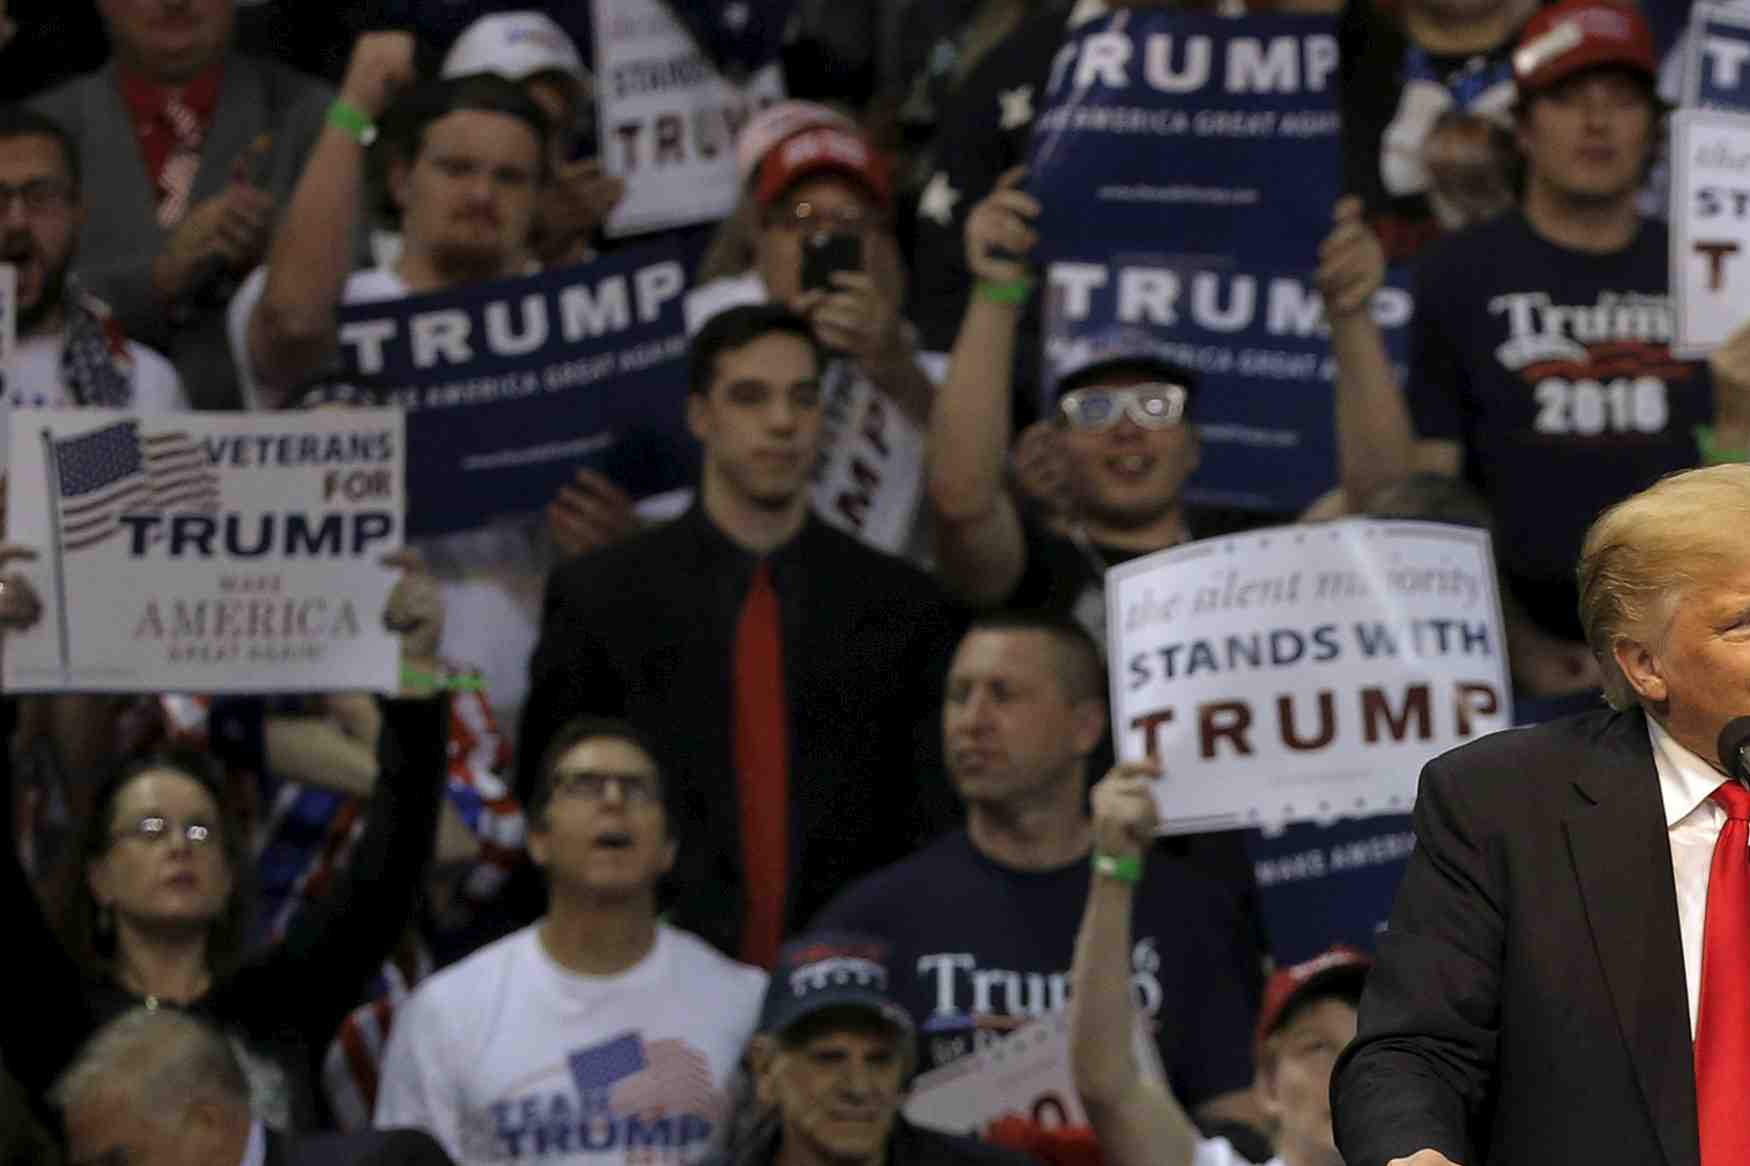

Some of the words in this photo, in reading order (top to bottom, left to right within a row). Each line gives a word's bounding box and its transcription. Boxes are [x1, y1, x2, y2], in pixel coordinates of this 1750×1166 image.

[1052, 31, 1339, 94] RUMP
[336, 259, 686, 375] TRUMP
[1488, 290, 1673, 345] Trum
[1533, 376, 1667, 434] 2016
[204, 431, 393, 467] VETERANS
[323, 469, 392, 500] FOR
[119, 512, 393, 559] TRUMP
[133, 598, 362, 639] AMERICA
[1129, 622, 1341, 691] STANDS
[1355, 618, 1493, 659] WITH
[1131, 681, 1499, 768] TRUMP
[496, 1112, 713, 1158] TRUMP
